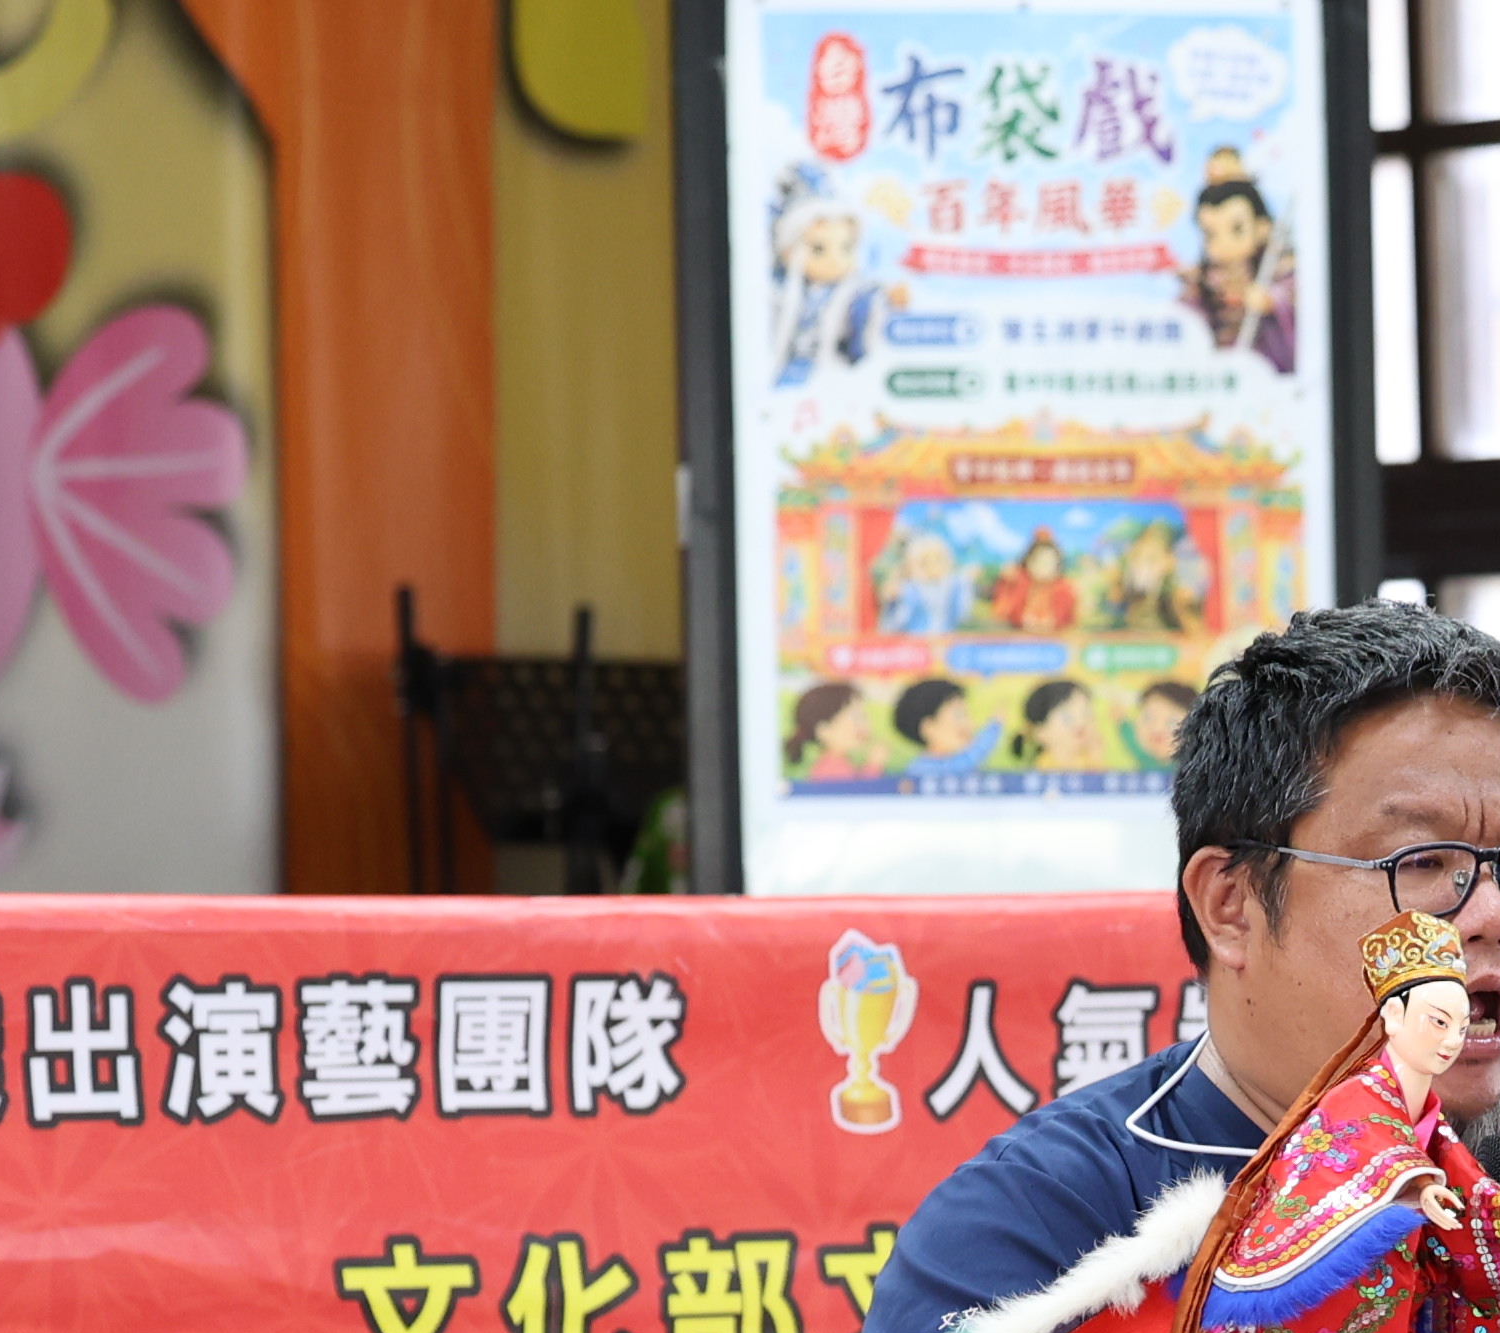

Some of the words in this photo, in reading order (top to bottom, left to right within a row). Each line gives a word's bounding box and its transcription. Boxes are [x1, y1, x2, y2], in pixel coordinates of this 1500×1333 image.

[881, 53, 1176, 164] 布袋戲
[923, 177, 1141, 235] 百年風華
[928, 975, 1210, 1118] 人氣
